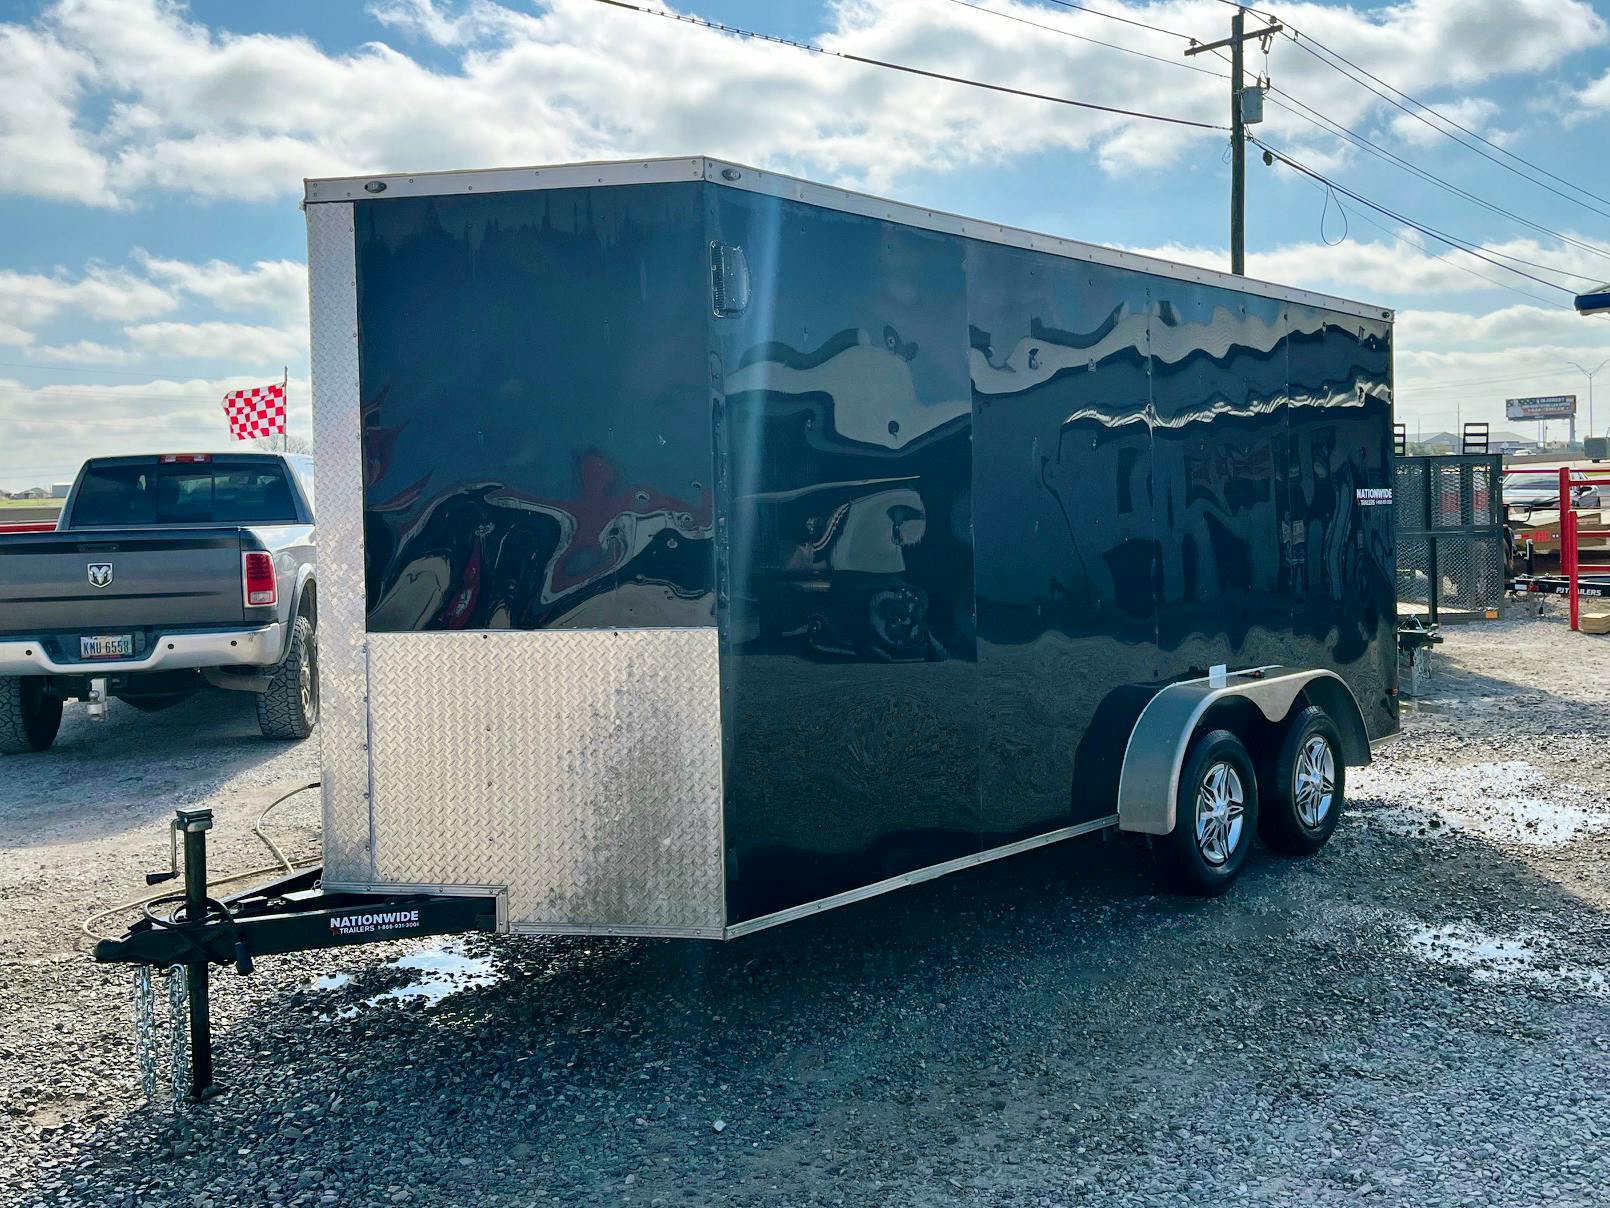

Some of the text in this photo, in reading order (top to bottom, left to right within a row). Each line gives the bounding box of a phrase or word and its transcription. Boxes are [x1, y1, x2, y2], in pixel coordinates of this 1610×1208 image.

[1356, 488, 1393, 499] NATIONWIDE
[1564, 587, 1602, 597] TILERS
[83, 640, 129, 655] KMU 6558
[329, 910, 419, 928] NATIONWIDE
[339, 924, 375, 935] TRAILERS
